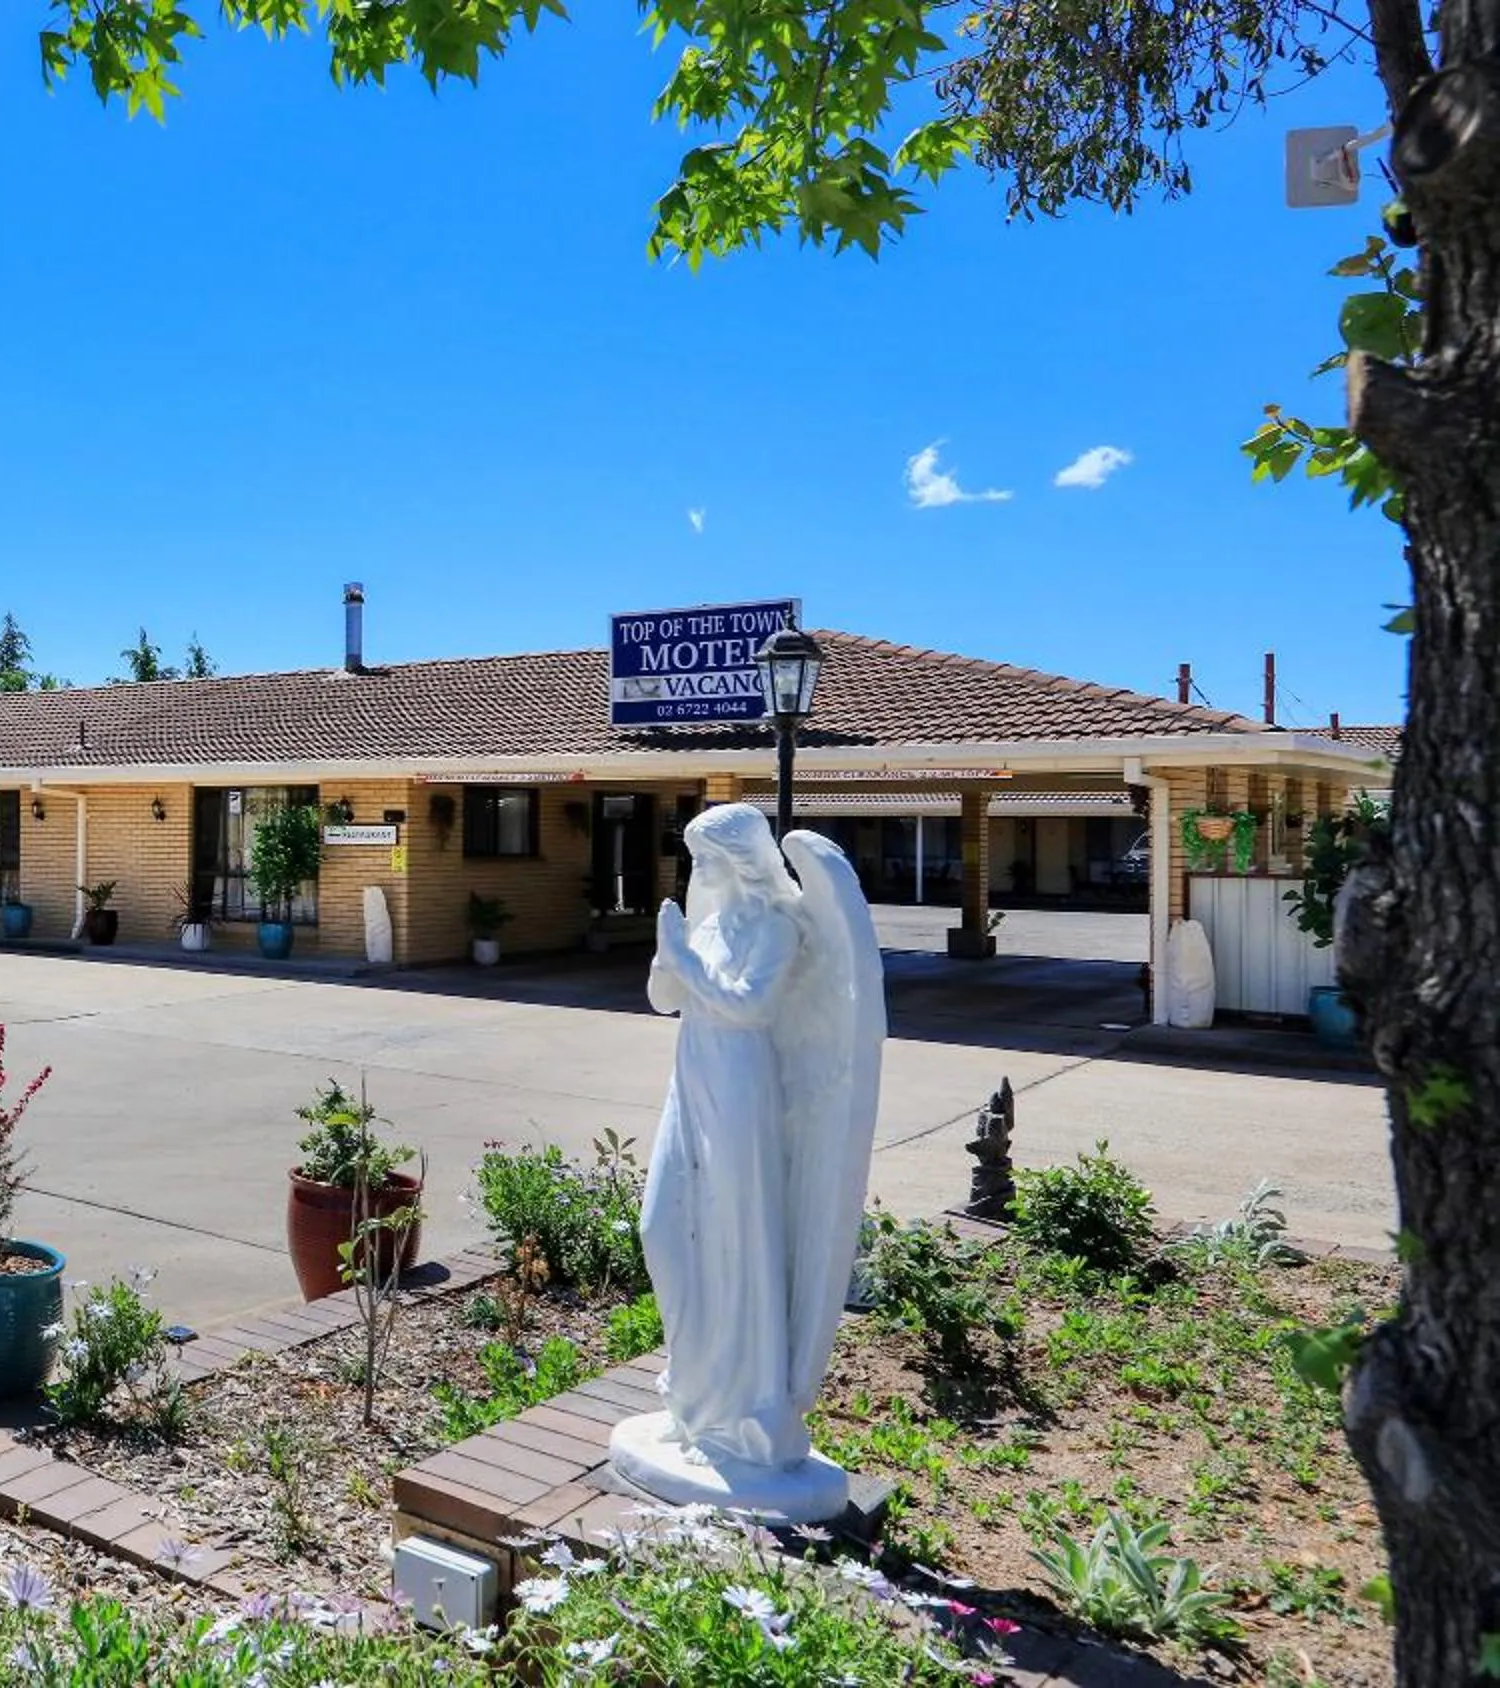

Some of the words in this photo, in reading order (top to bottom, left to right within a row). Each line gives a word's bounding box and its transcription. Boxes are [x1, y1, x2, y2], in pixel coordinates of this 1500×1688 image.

[619, 621, 655, 644] TOP
[659, 618, 683, 638] OF
[687, 615, 726, 635] THE
[729, 610, 789, 633] TOWN
[639, 637, 759, 671] MOTEL
[664, 672, 764, 697] VACANC
[656, 704, 673, 717] 02
[677, 703, 710, 716] 6722
[713, 701, 748, 714] 4044
